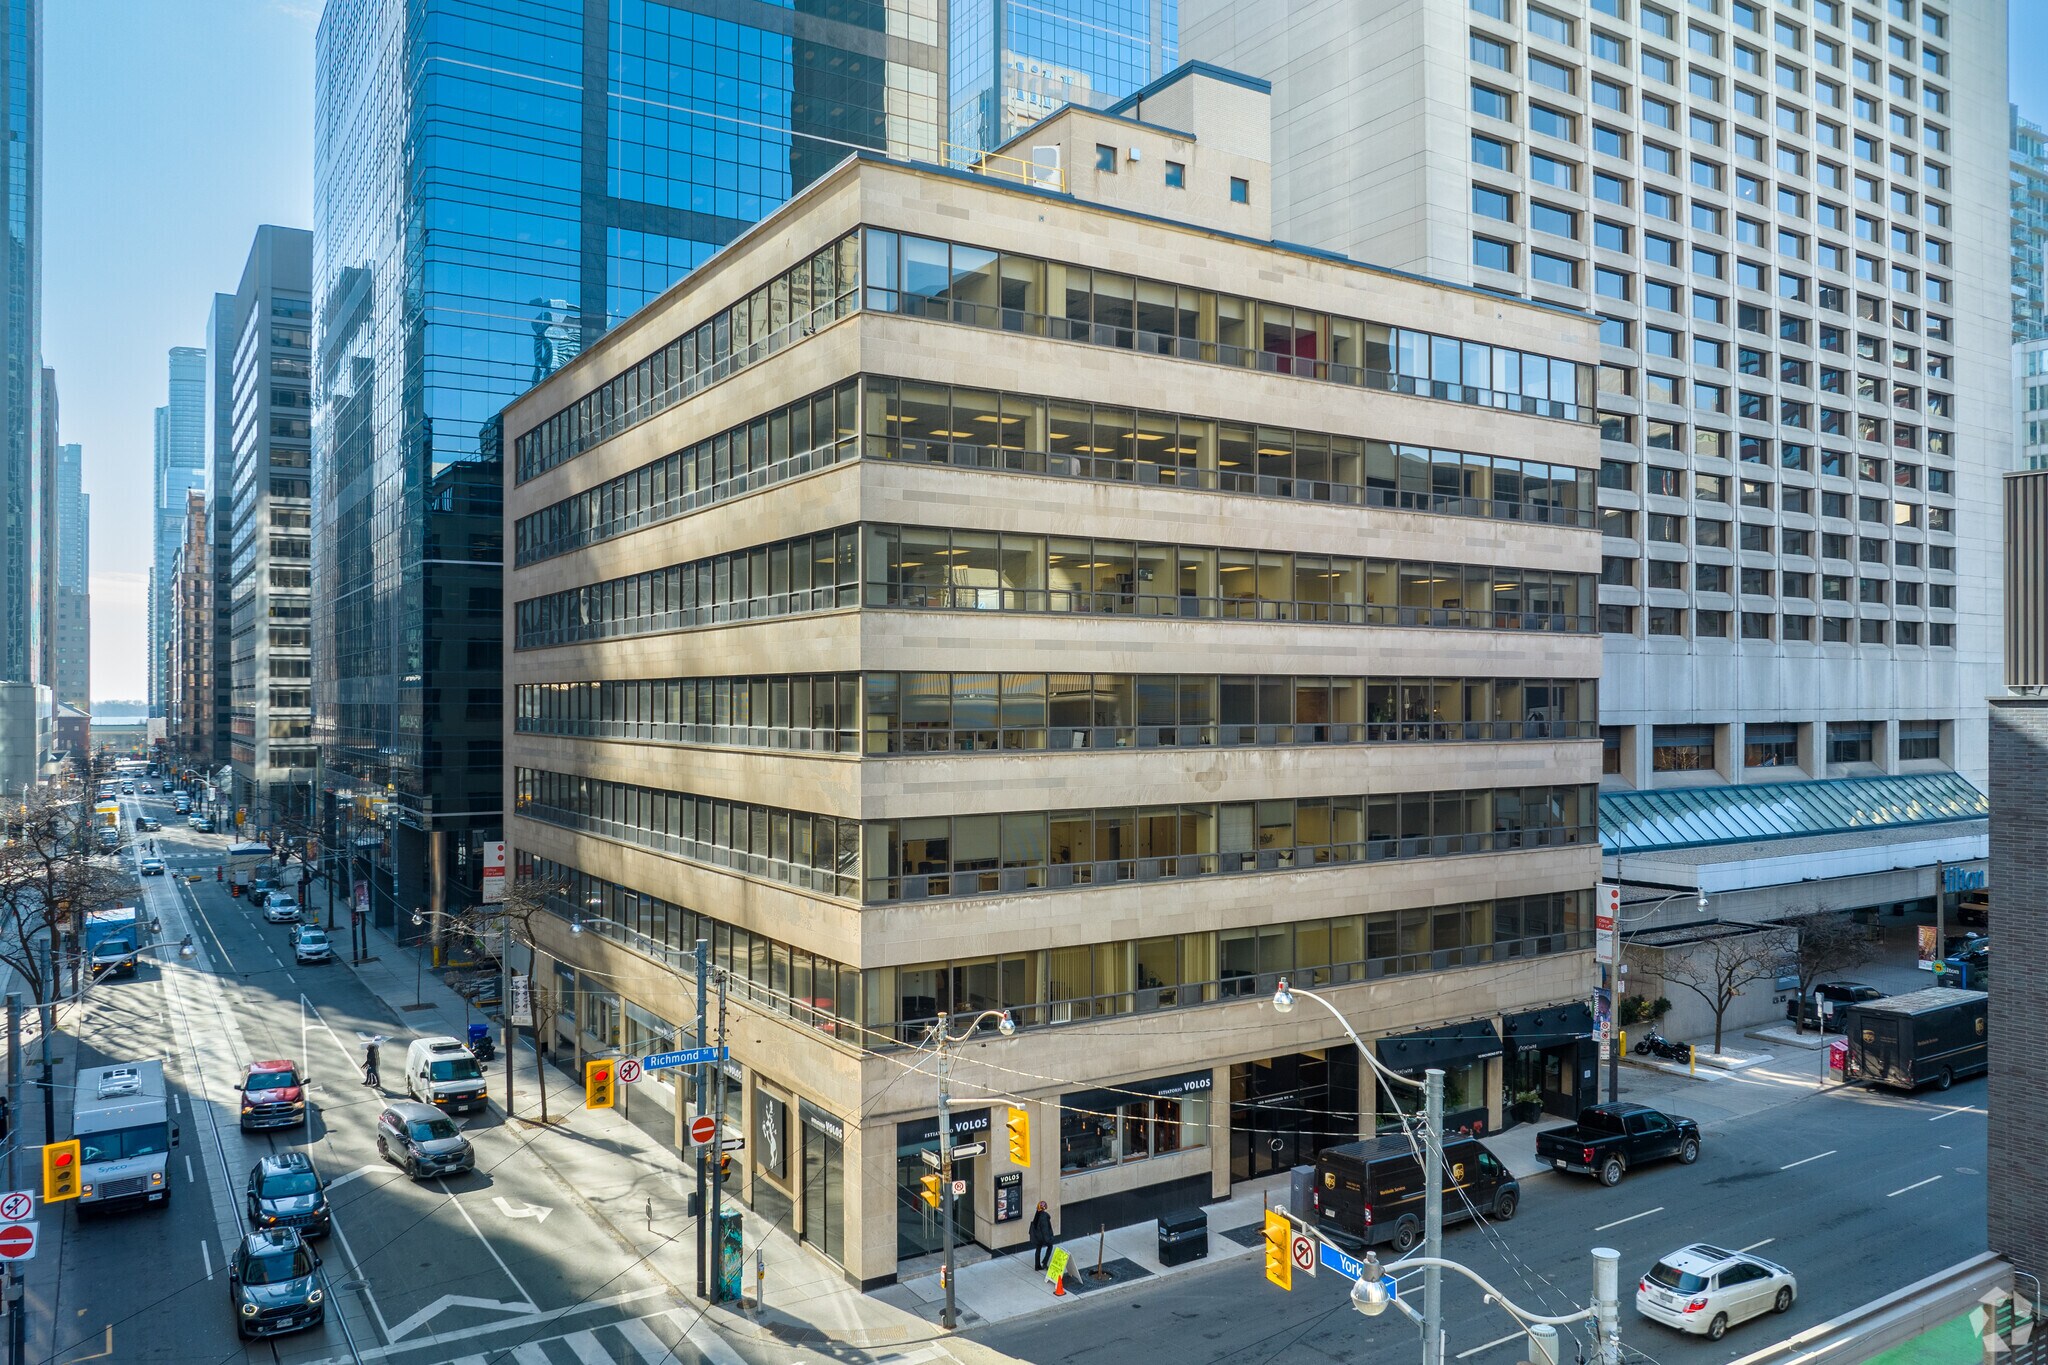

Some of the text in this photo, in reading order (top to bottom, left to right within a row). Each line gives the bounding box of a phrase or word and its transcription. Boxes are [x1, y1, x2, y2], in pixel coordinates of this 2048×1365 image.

[650, 1050, 699, 1067] Richmond
[1184, 1079, 1211, 1091] VOLOS
[825, 1121, 843, 1138] VOLOS
[955, 1118, 988, 1132] VOLOS
[1000, 1173, 1020, 1183] VOLOS
[1340, 1254, 1363, 1277] York
